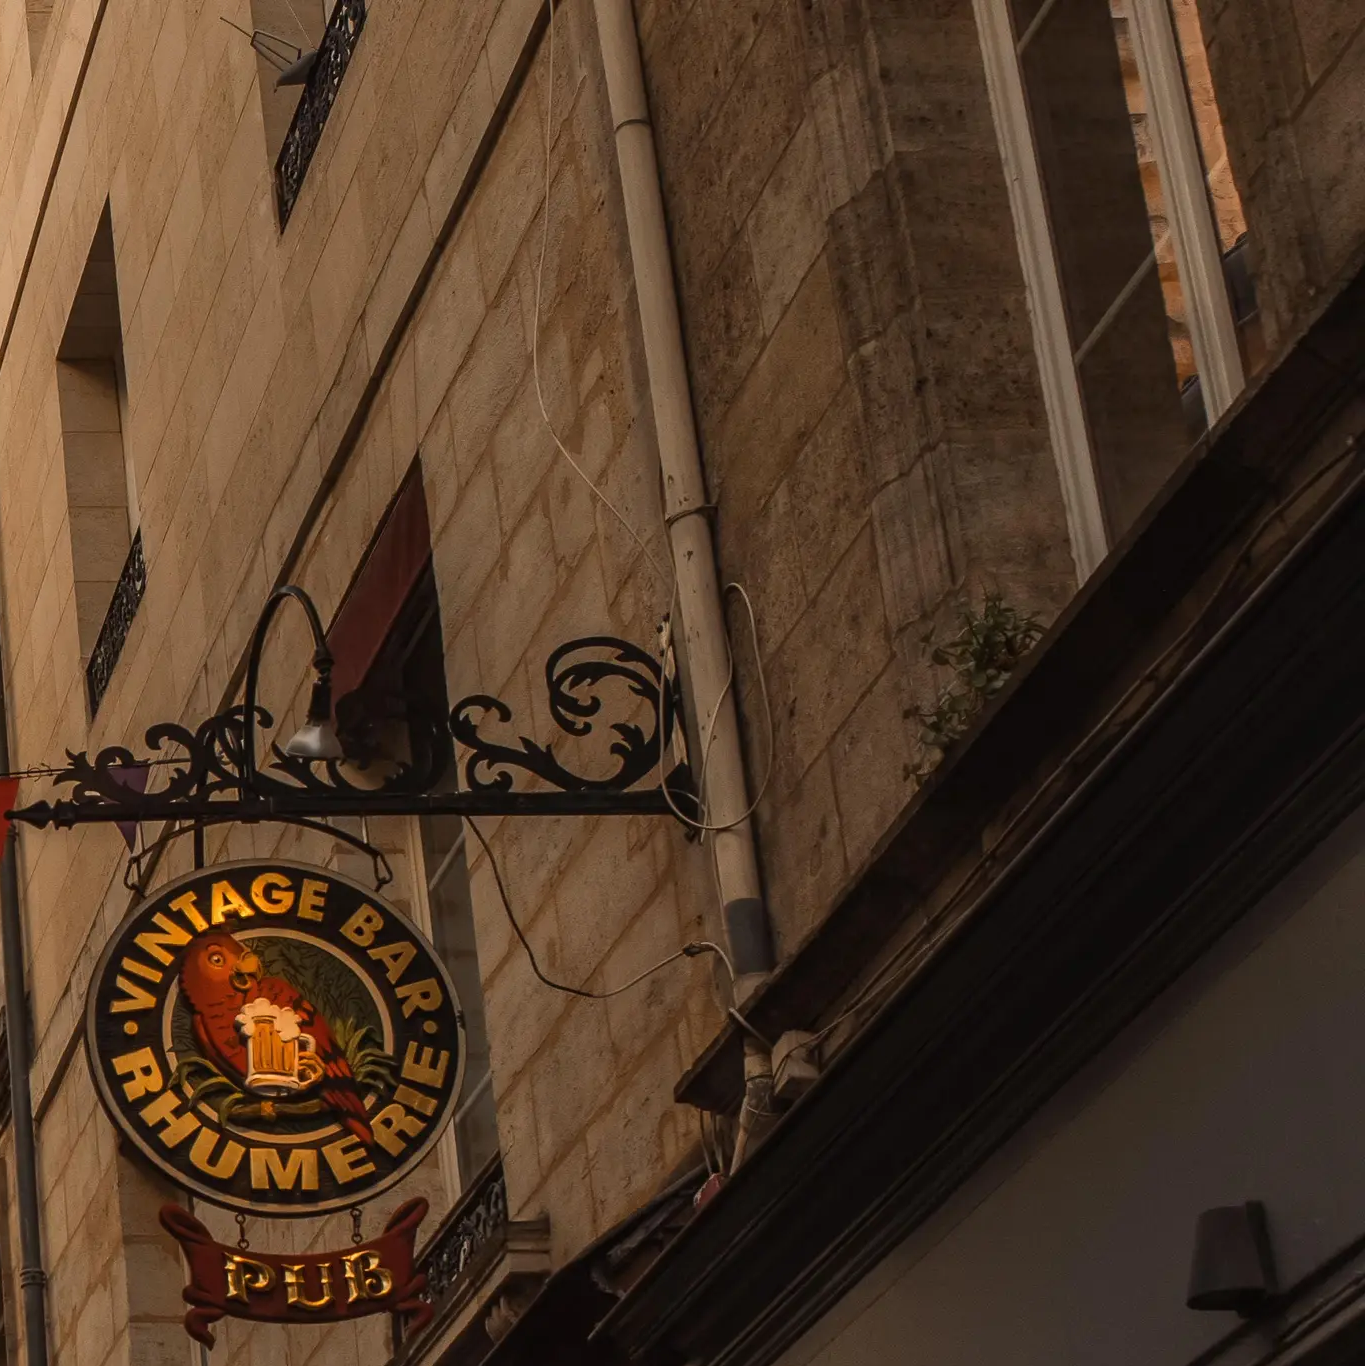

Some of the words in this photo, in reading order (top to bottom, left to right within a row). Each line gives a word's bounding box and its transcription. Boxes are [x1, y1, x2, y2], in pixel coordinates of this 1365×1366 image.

[110, 872, 330, 1014] VINTAGE
[339, 903, 443, 1018] BAR
[112, 1040, 450, 1190] RHUMERIE
[224, 1249, 394, 1310] PUB
